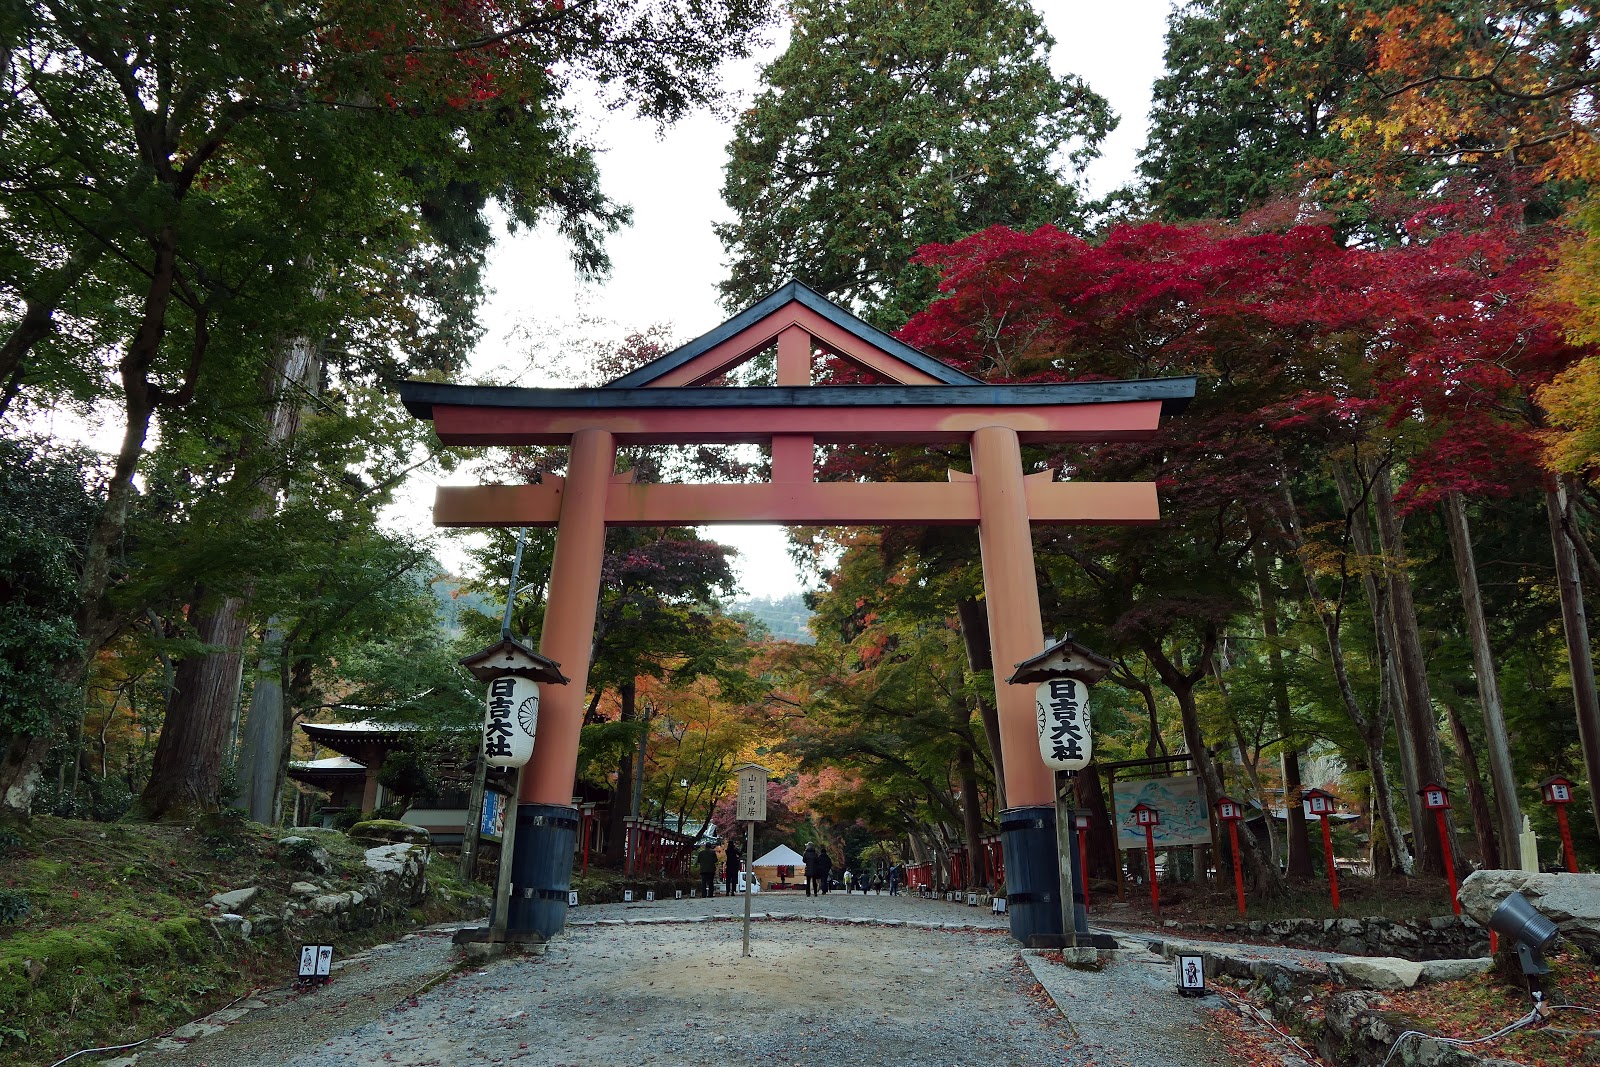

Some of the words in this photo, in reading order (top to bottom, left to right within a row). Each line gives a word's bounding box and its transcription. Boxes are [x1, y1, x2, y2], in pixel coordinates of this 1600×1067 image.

[486, 680, 516, 758] 日吉大社
[1049, 681, 1083, 761] 日吉大社
